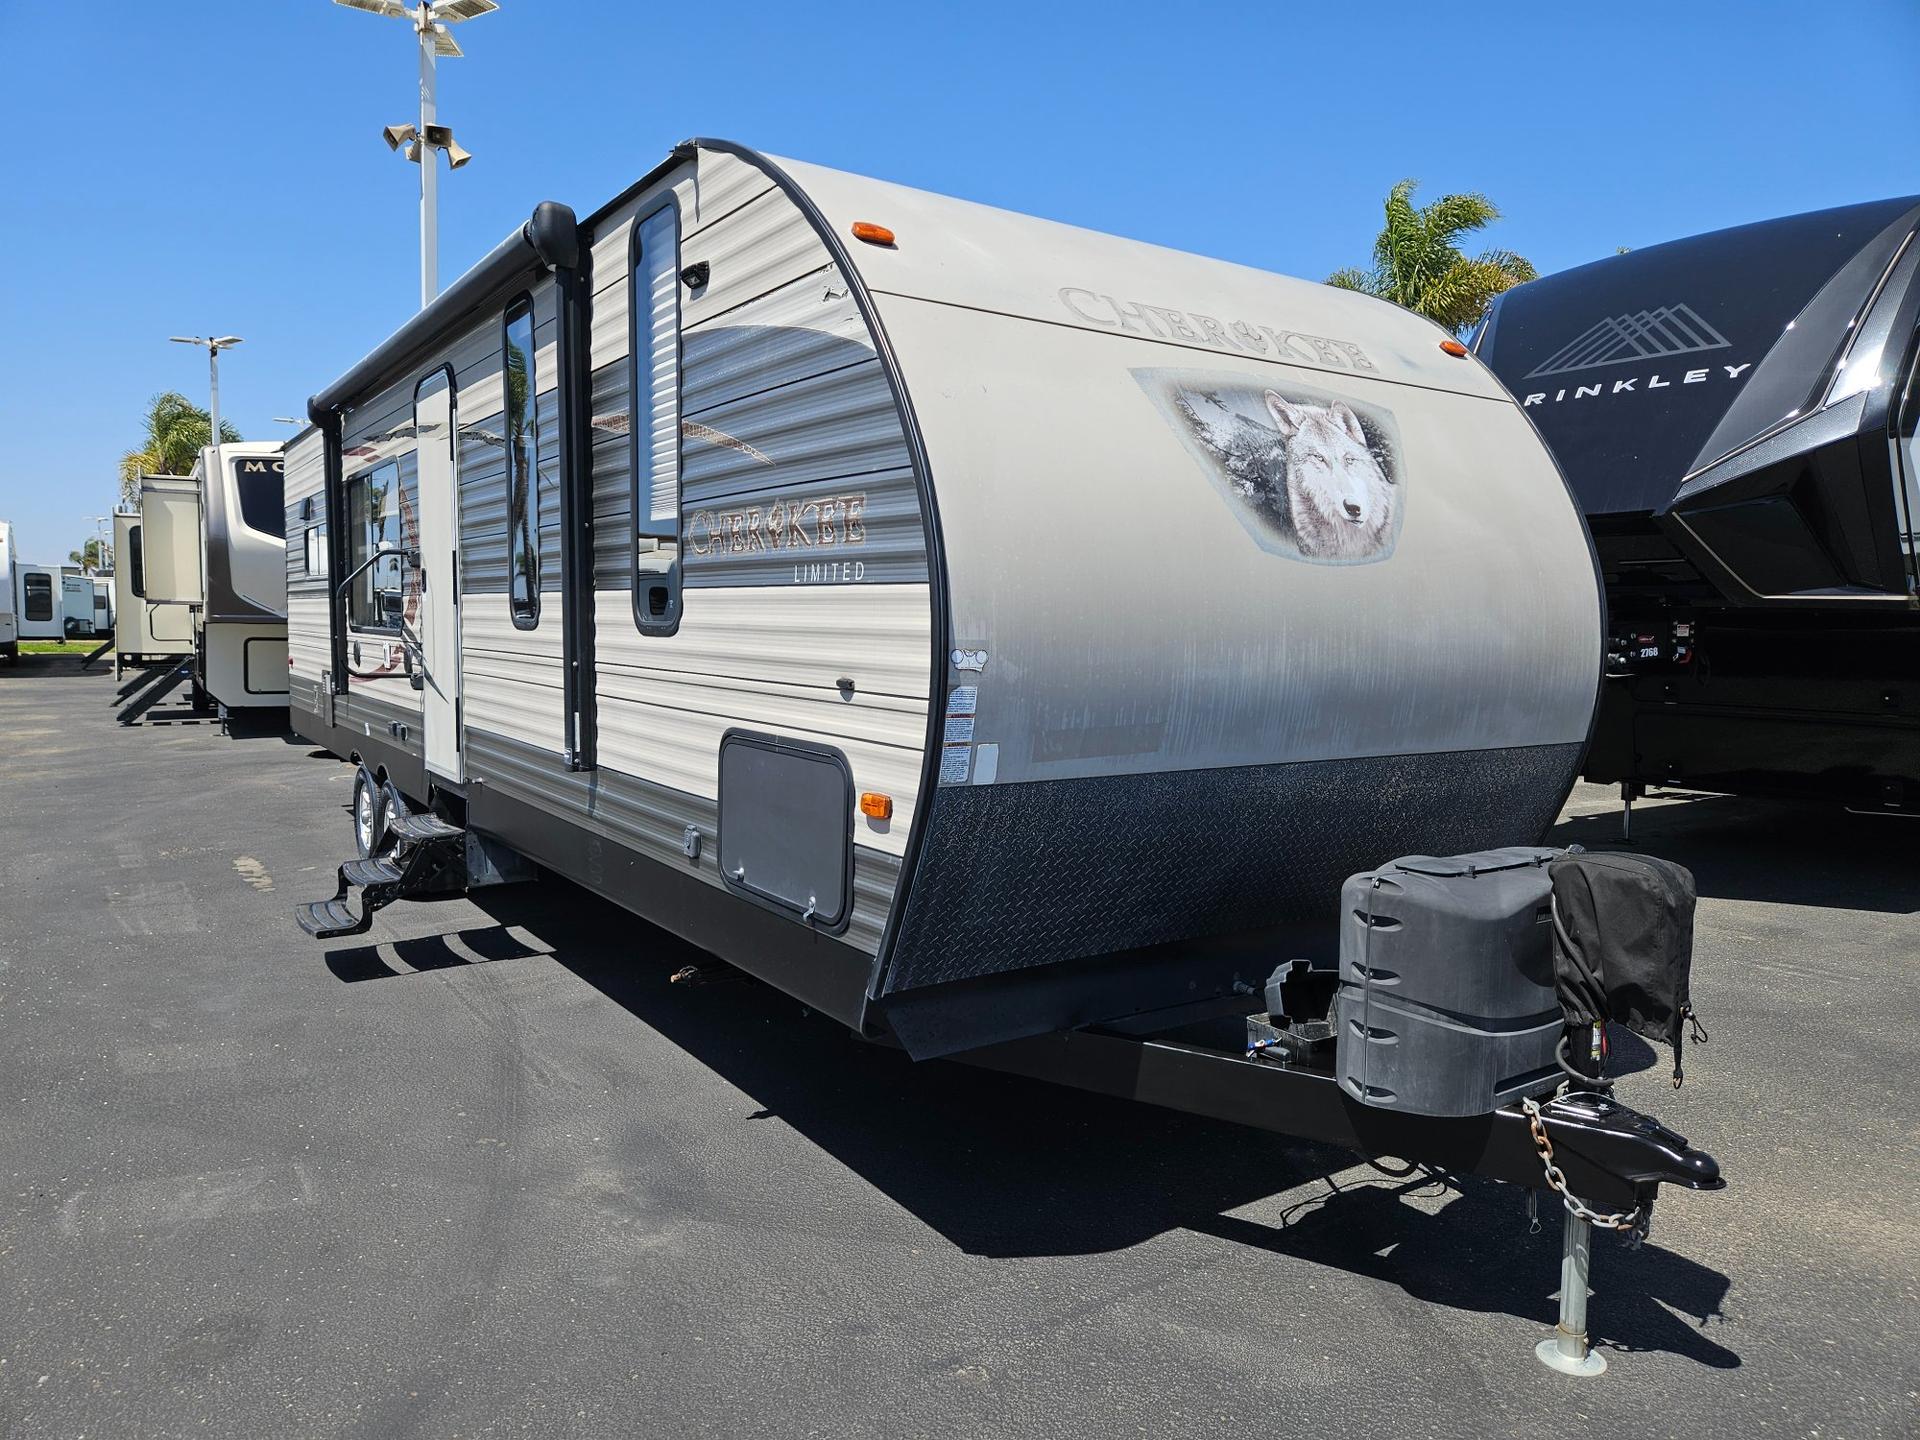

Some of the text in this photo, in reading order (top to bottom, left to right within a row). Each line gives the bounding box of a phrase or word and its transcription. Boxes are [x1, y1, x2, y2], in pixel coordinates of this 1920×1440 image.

[1057, 287, 1380, 374] CHEROKEE
[688, 493, 866, 555] CHEROKEE
[794, 561, 865, 583] LIMITED
